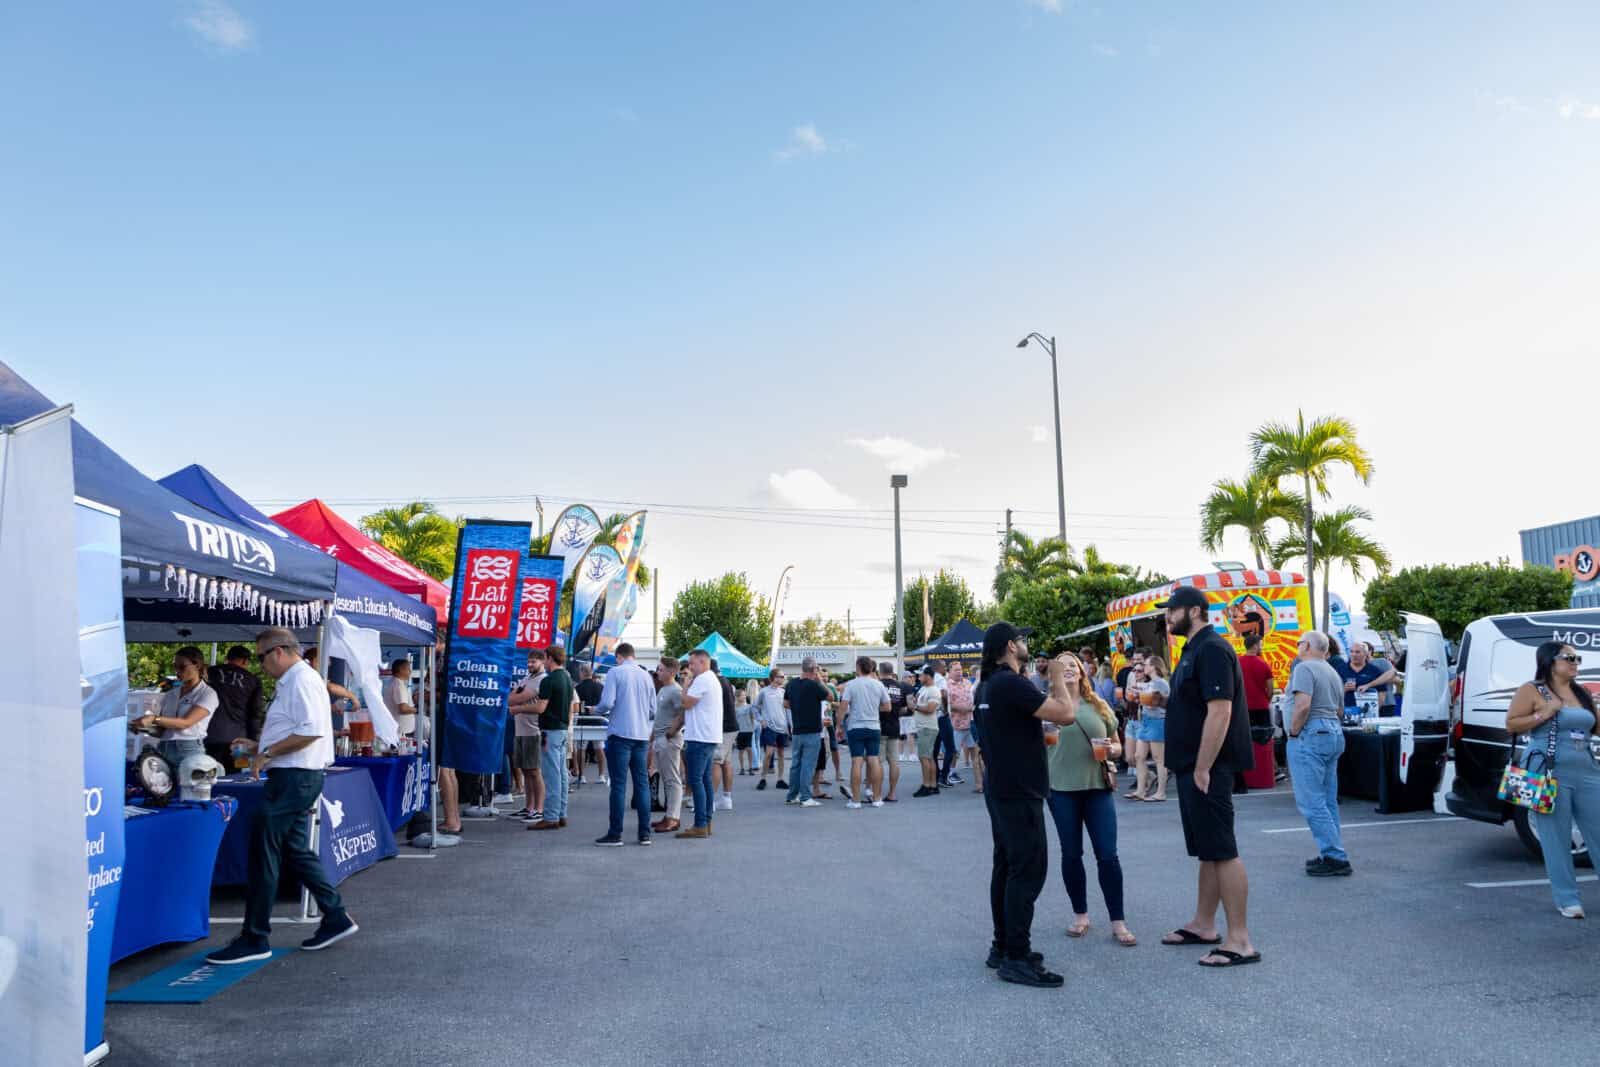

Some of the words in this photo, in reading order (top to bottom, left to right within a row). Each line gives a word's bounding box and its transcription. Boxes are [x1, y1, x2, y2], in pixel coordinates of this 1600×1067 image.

[468, 581, 508, 602] Lat
[456, 659, 499, 673] Clean
[453, 676, 499, 690] Polish
[448, 692, 503, 707] Protect
